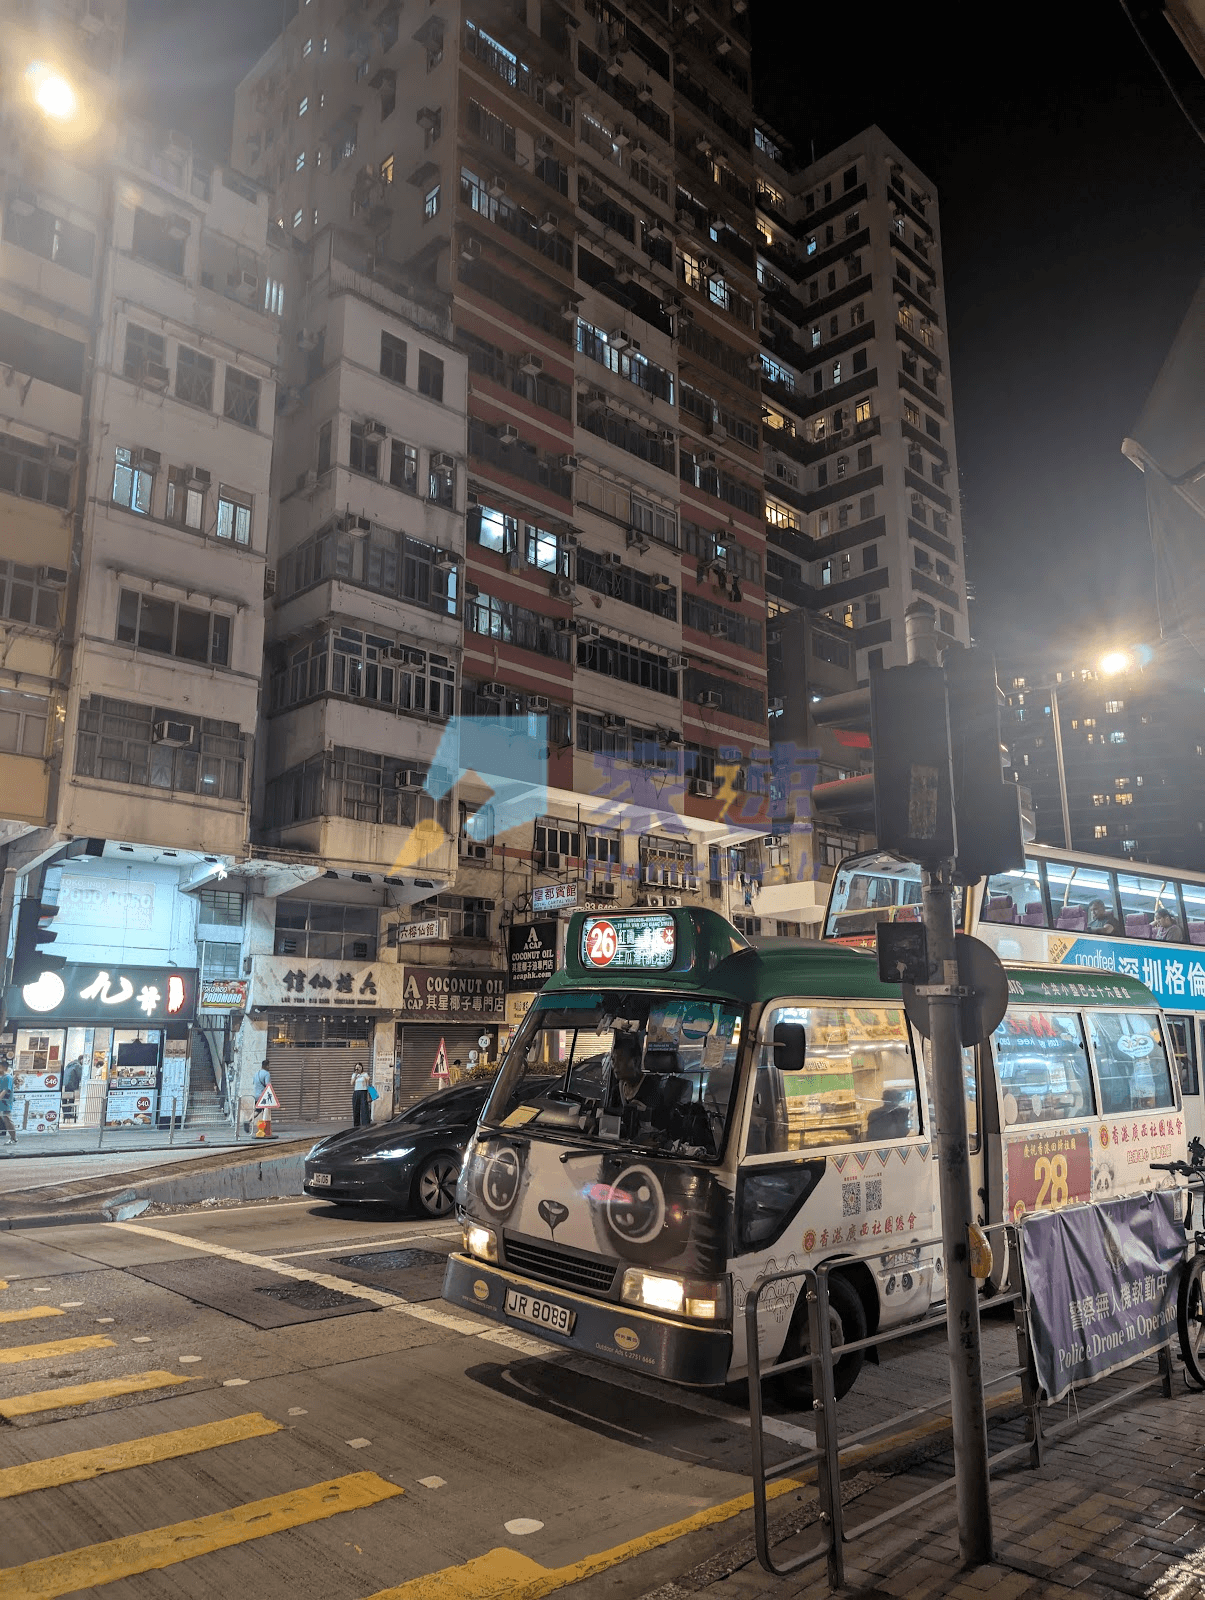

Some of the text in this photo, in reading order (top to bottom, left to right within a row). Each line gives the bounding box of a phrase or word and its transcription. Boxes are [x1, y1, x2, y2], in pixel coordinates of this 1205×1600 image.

[400, 923, 435, 939] 六榕仙館
[527, 926, 539, 942] A
[591, 928, 614, 958] 26
[511, 949, 554, 961] COCONUT OIL
[426, 976, 505, 994] COCONUT OIL
[512, 972, 552, 981] acaphk.com
[403, 975, 421, 999] A
[1007, 979, 1024, 995] ATS
[203, 993, 242, 1003] PODOMORO
[425, 993, 504, 1012] 其星椰子專門店
[1034, 1153, 1069, 1211] 28
[820, 1211, 917, 1247] 香港廣西社團總會
[1069, 1271, 1168, 1332] 警察無人機執勤中
[509, 1294, 528, 1315] JR
[532, 1300, 567, 1329] 8089
[1058, 1342, 1092, 1374] Police
[1091, 1329, 1125, 1358] Drone
[1126, 1321, 1136, 1342] in
